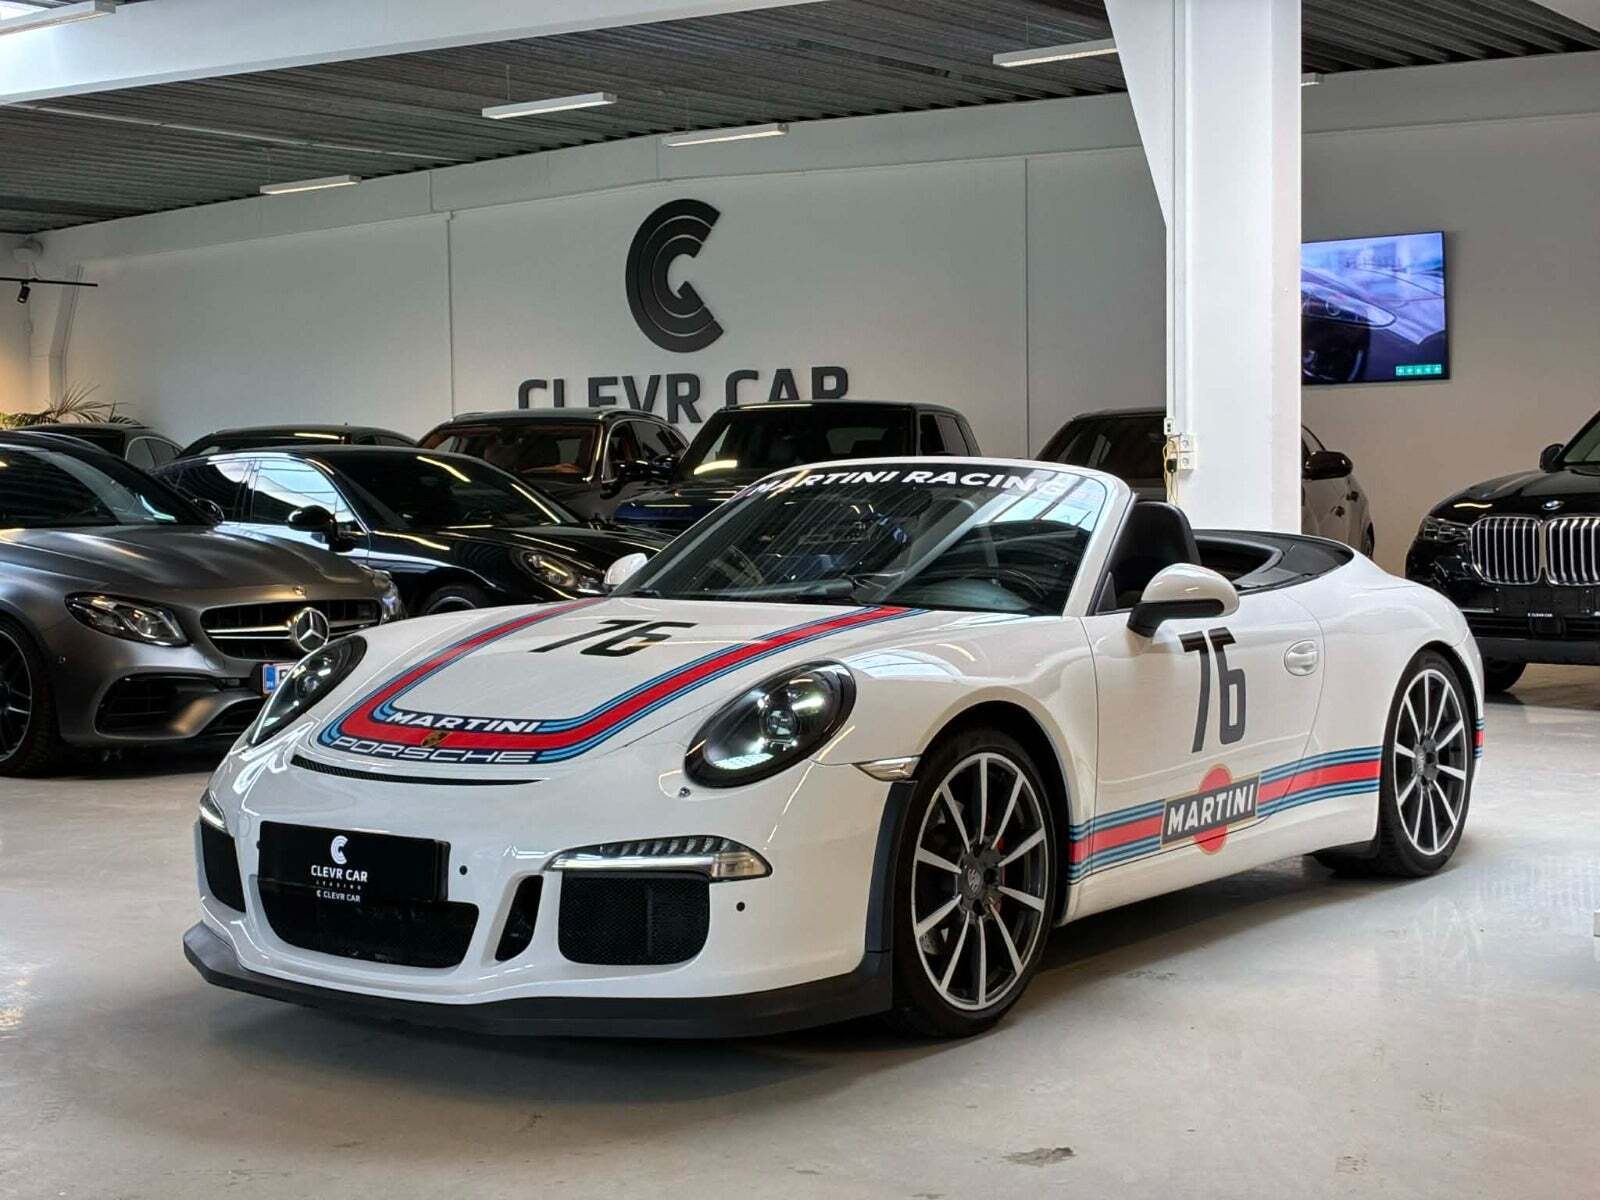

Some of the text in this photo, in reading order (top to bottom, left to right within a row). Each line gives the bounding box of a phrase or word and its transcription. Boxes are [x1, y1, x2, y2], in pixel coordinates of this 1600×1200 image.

[528, 619, 698, 657] 76
[1178, 627, 1246, 753] 76
[388, 711, 541, 733] MARTINI
[330, 737, 539, 764] PORSCHE
[1166, 784, 1255, 835] MARTINI
[311, 865, 368, 883] CLEVR CAR
[323, 890, 345, 901] CLEVR
[346, 893, 361, 903] CAR
